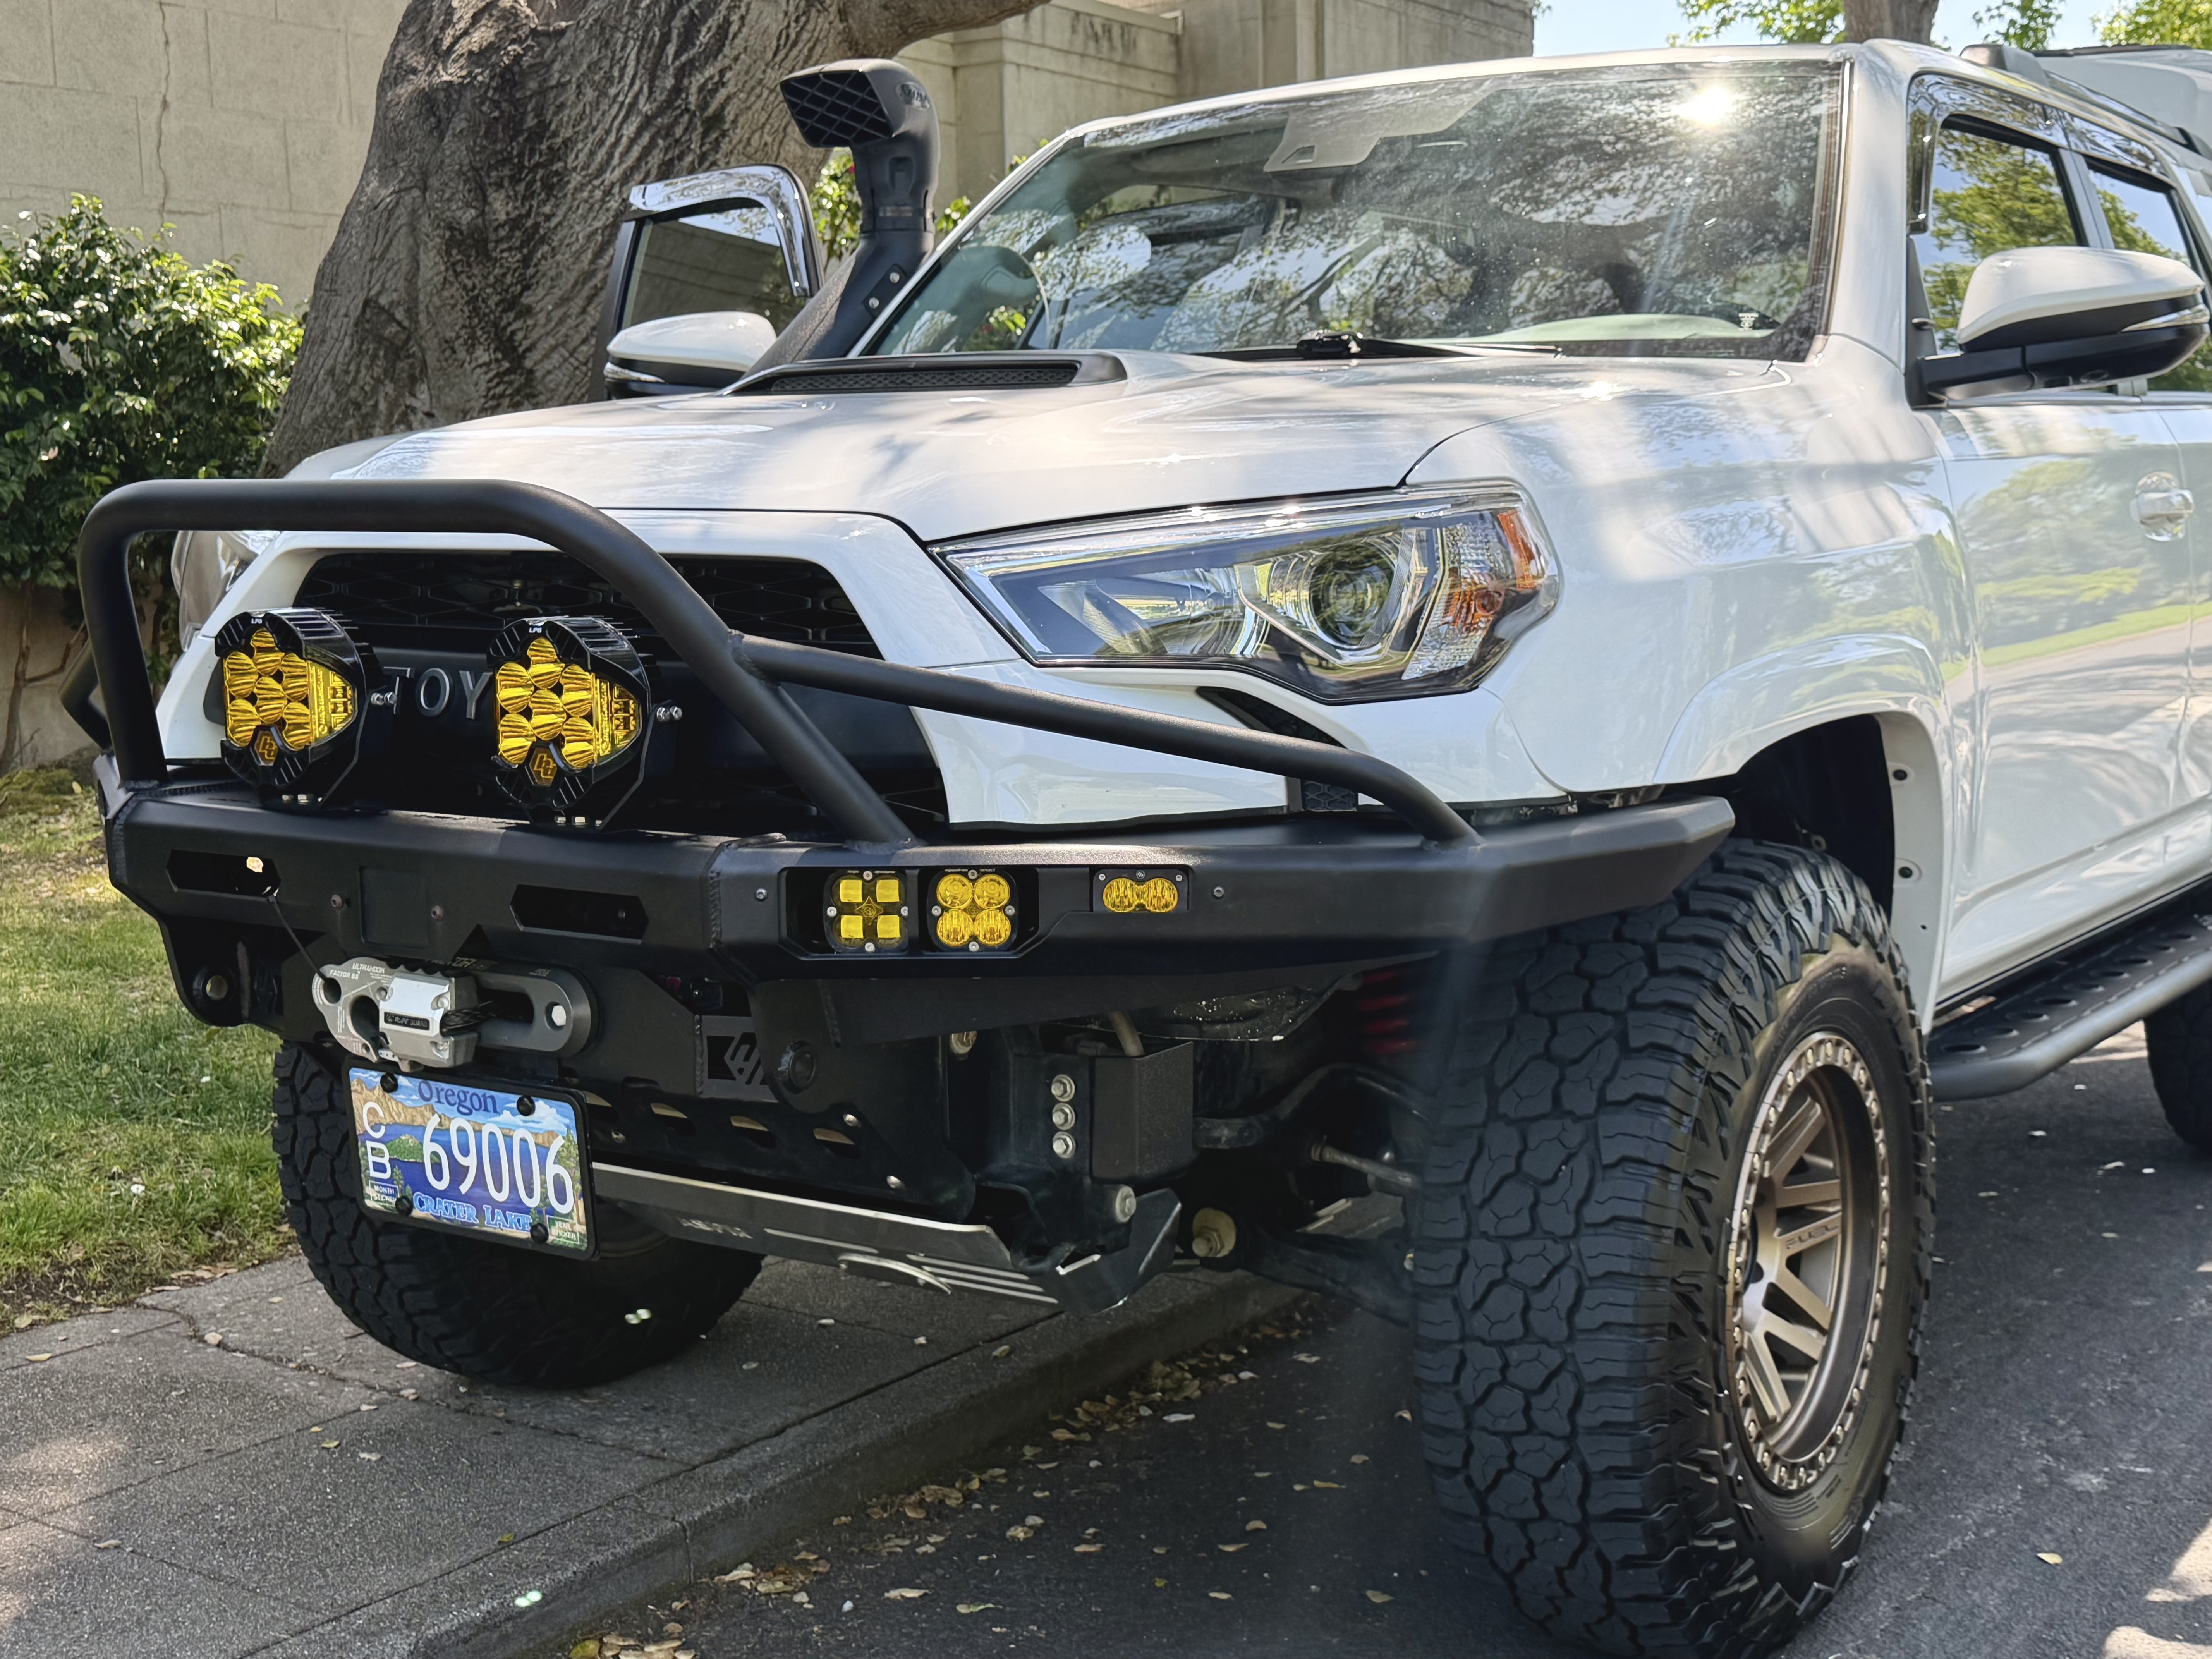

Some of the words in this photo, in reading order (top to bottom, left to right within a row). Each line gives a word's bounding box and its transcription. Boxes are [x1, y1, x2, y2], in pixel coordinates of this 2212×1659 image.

[330, 969, 350, 978] FACTOR
[418, 1080, 500, 1116] Oregon
[423, 1114, 574, 1214] 69006
[413, 1192, 479, 1223] CRATER
[483, 1204, 532, 1232] LAKE
[555, 1220, 572, 1231] YEAR
